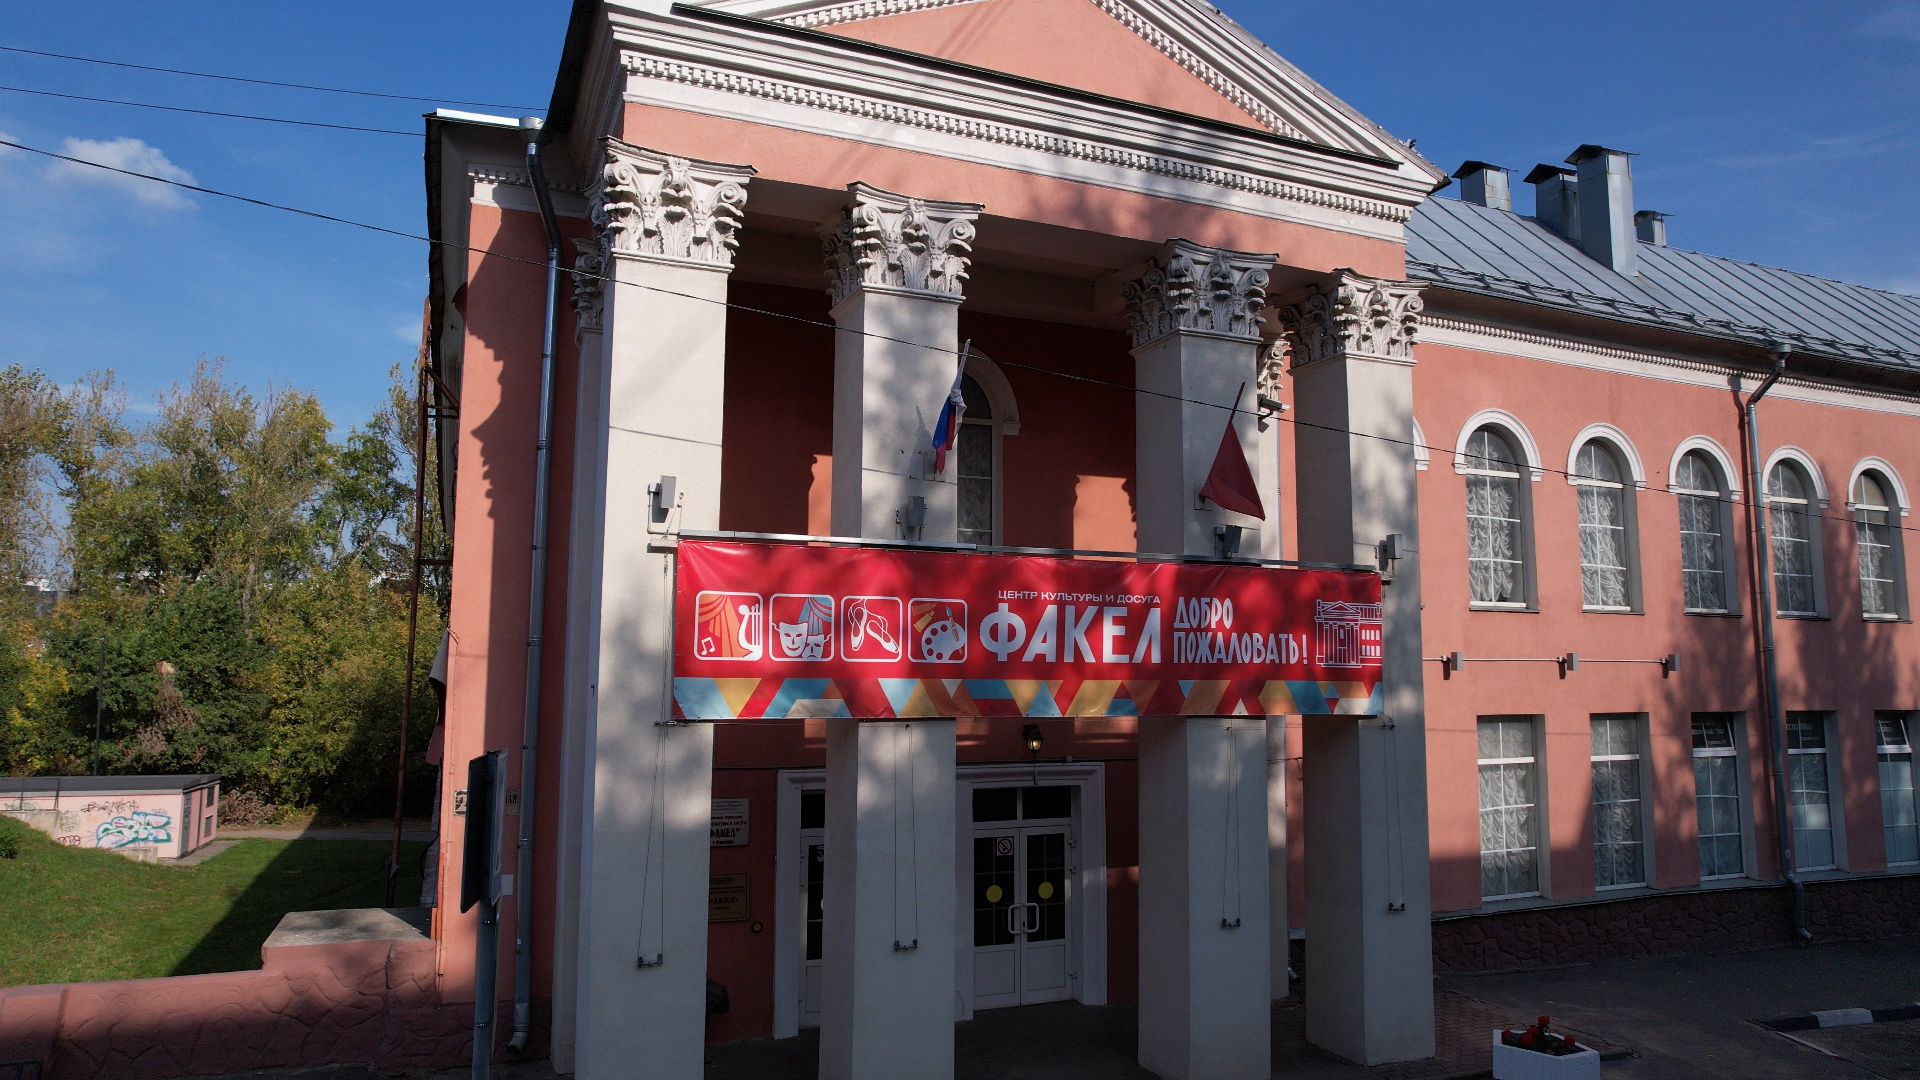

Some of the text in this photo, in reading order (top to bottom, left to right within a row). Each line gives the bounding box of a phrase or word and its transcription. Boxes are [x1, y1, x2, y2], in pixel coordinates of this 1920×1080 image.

[998, 590, 1160, 604] ЦЕНТР КУЛЬТУРЫ И ДОСУГА
[1173, 597, 1233, 629] ДОБРО
[979, 602, 1161, 664] ФАКЕЛ
[1173, 632, 1308, 665] ПОЖАЛОВАТЬ!
